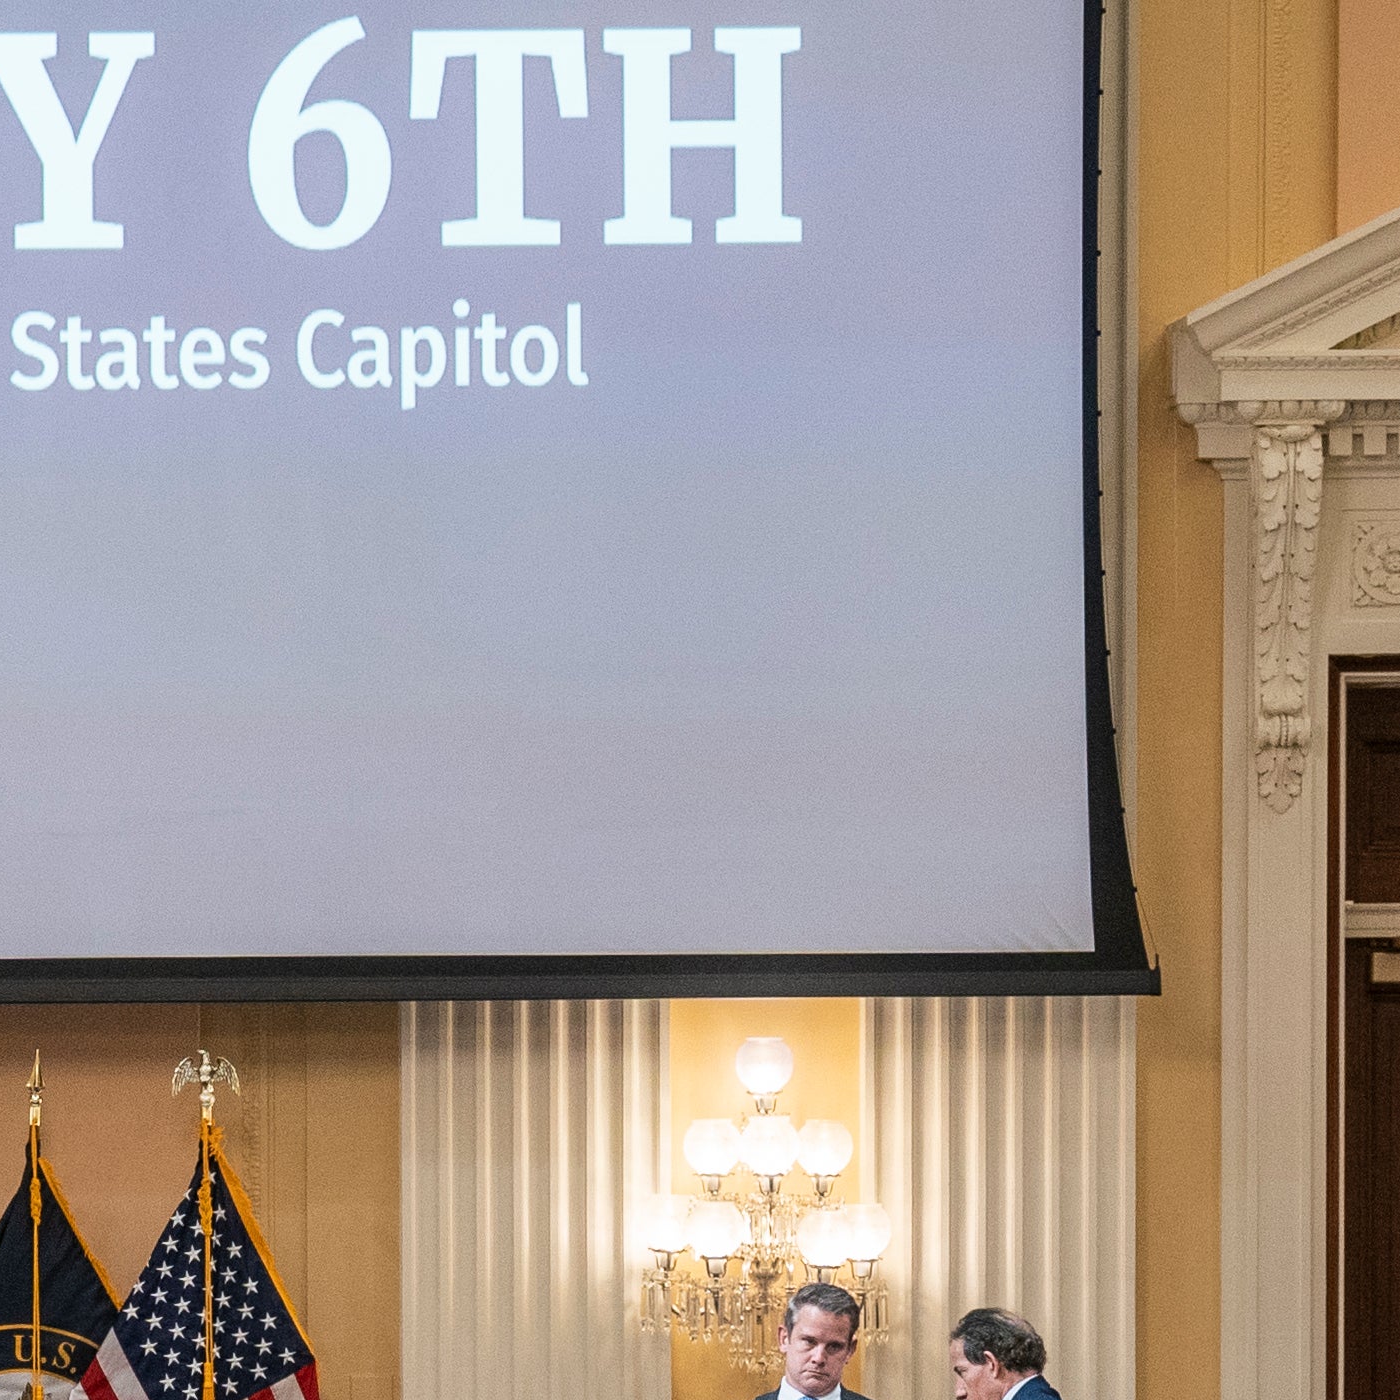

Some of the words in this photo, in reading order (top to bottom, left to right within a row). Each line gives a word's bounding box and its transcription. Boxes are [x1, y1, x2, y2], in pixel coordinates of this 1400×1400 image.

[246, 14, 804, 253] 6TH
[9, 310, 271, 392] States
[296, 297, 589, 411] Capitol
[13, 1334, 77, 1375] U.S.
